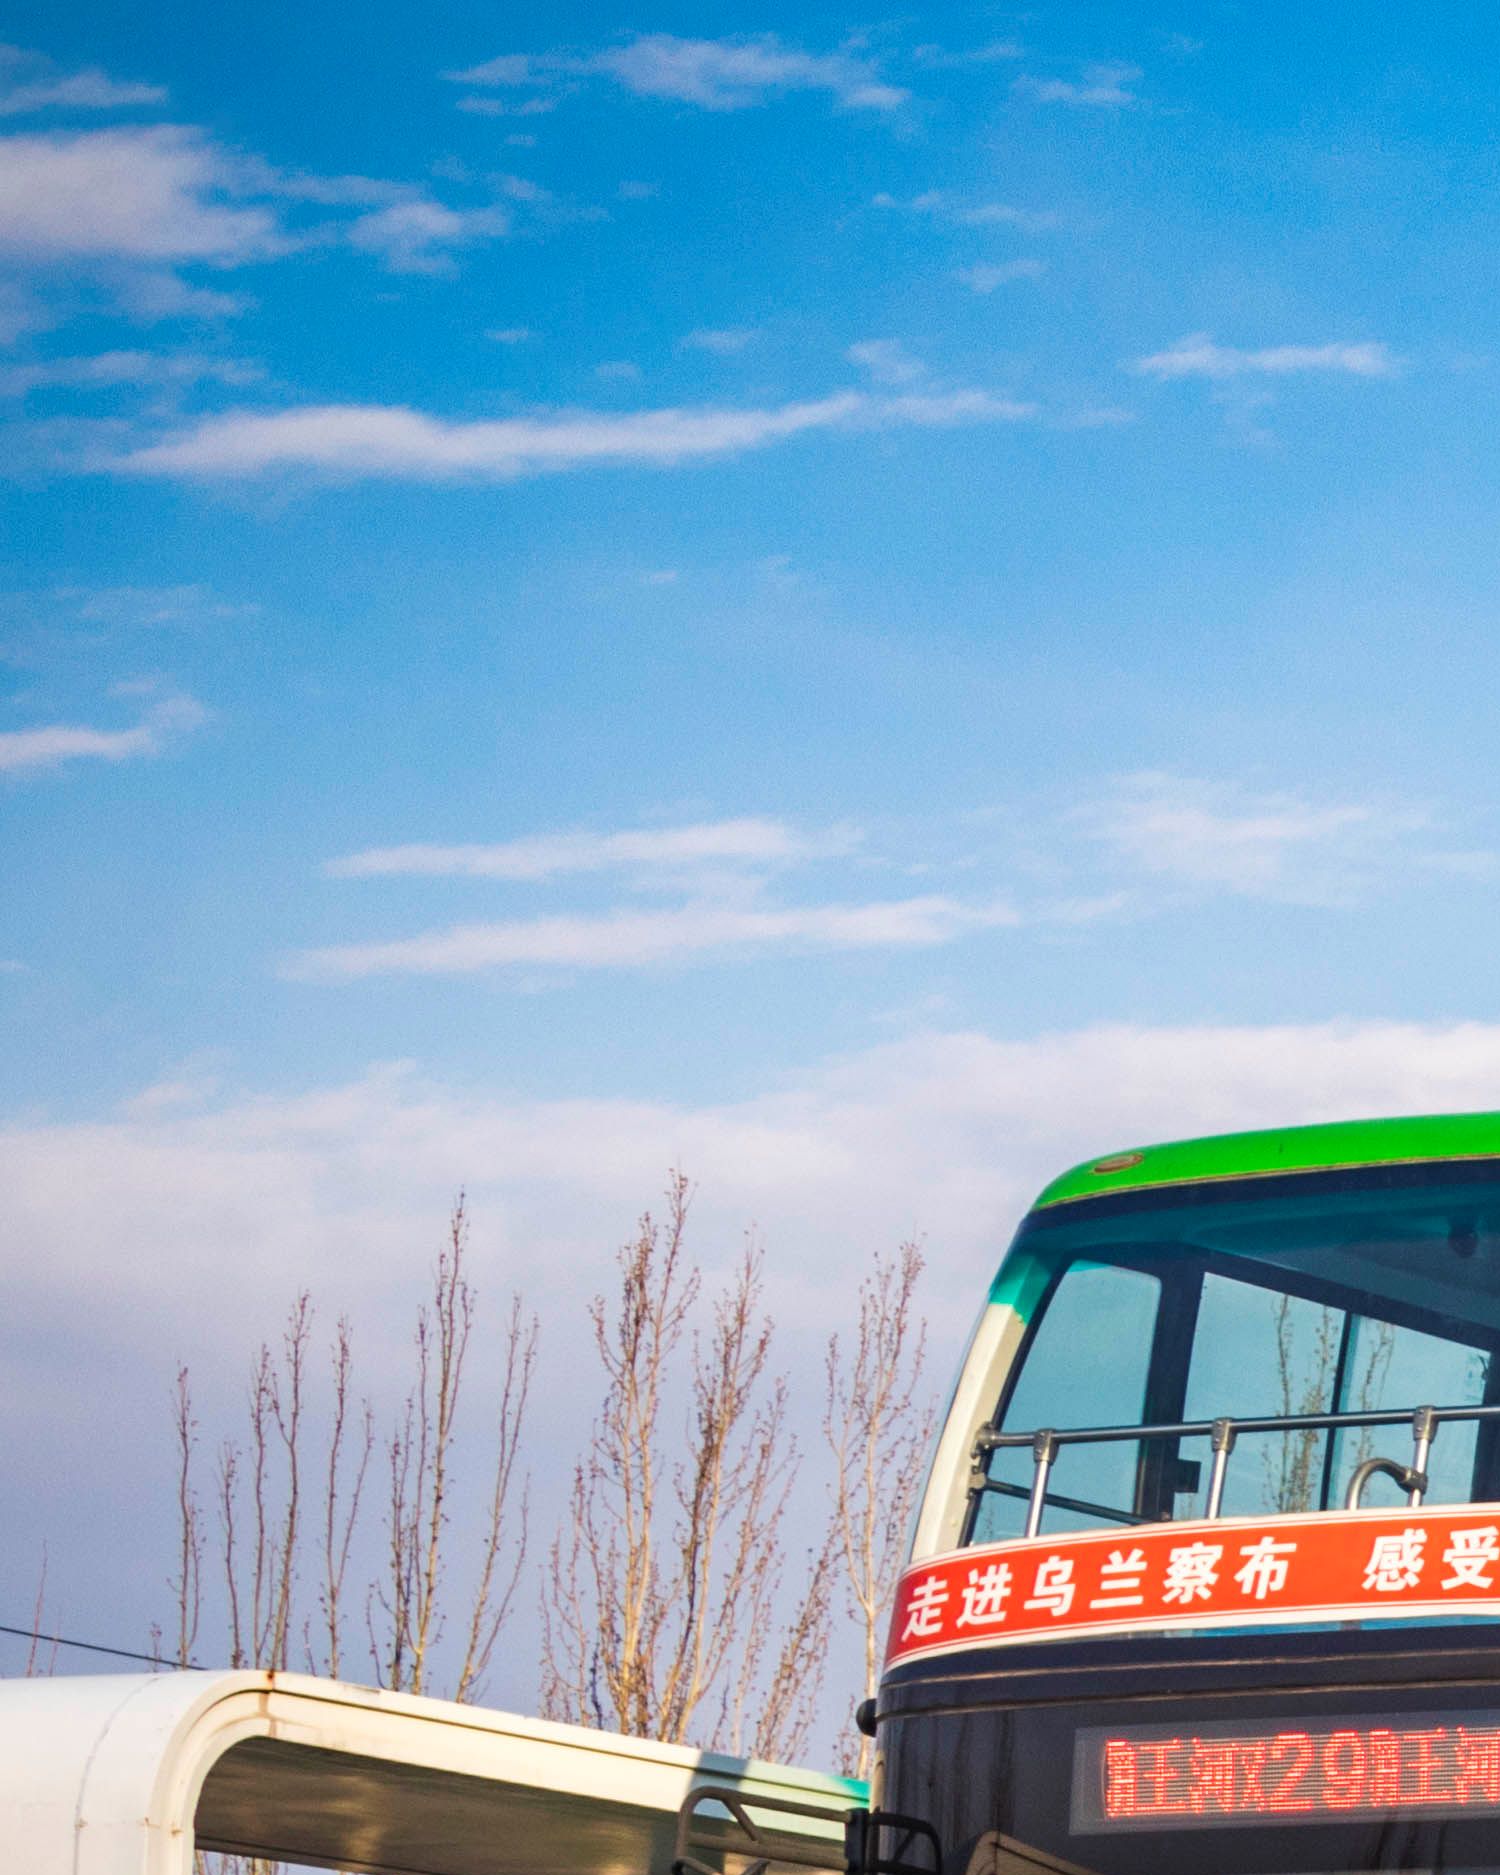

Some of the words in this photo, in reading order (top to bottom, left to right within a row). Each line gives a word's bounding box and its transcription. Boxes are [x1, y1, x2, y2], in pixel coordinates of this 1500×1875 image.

[900, 1535, 1298, 1640] 走进乌兰察布
